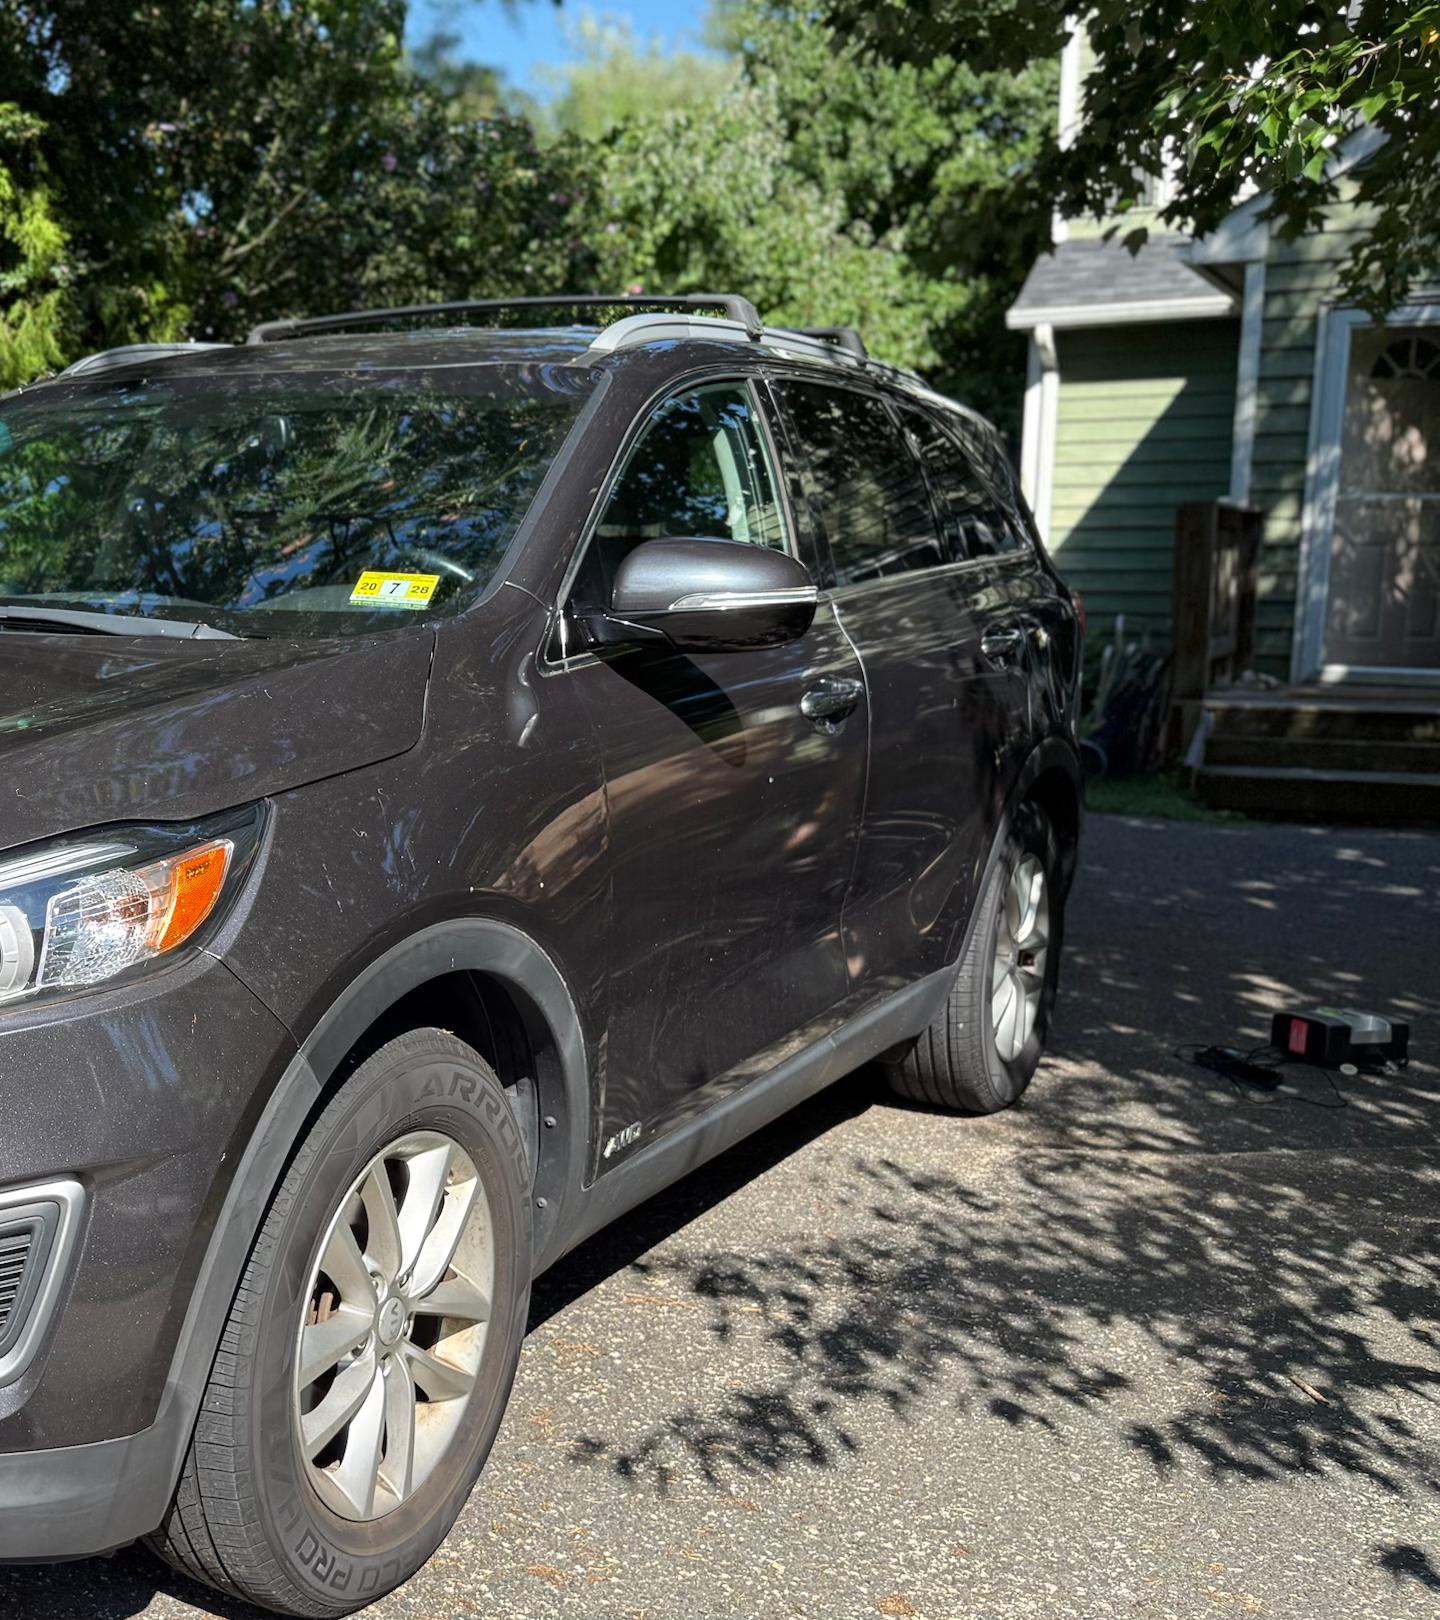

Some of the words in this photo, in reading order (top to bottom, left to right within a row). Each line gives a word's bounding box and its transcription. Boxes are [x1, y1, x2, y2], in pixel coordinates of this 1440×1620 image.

[360, 582, 377, 591] 20
[389, 582, 402, 594] 7
[410, 585, 430, 594] 28
[295, 1526, 353, 1591] PRO
